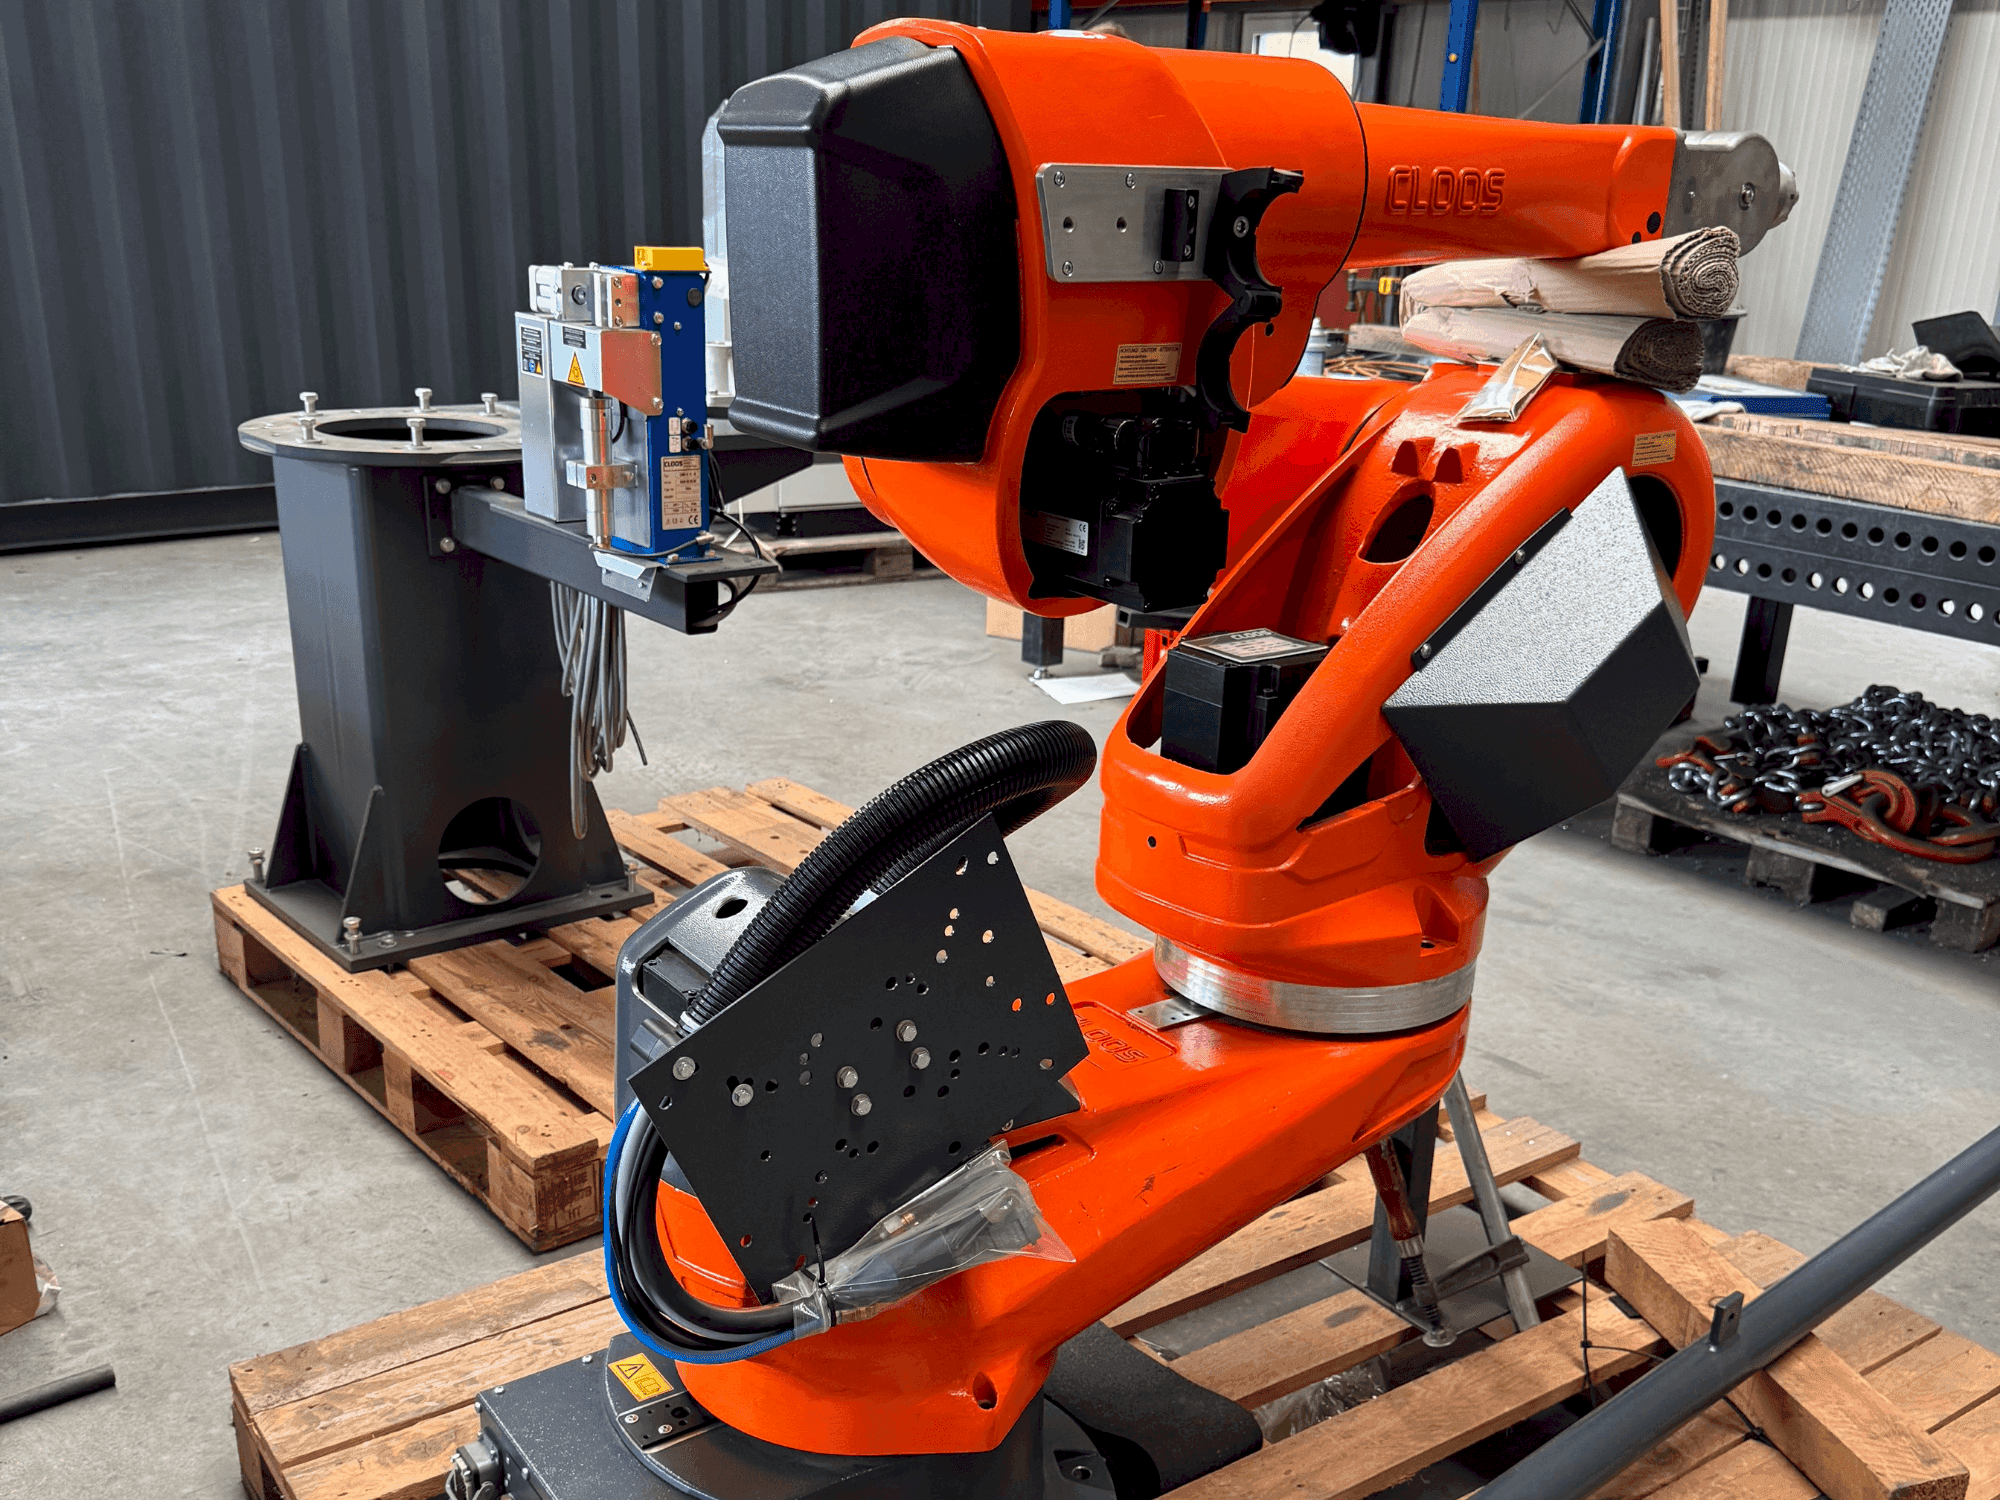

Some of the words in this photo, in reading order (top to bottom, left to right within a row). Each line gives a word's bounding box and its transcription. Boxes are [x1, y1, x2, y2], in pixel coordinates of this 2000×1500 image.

[1387, 165, 1506, 213] CLOOS
[663, 460, 683, 468] CLOOS
[1230, 630, 1272, 640] CLOOS
